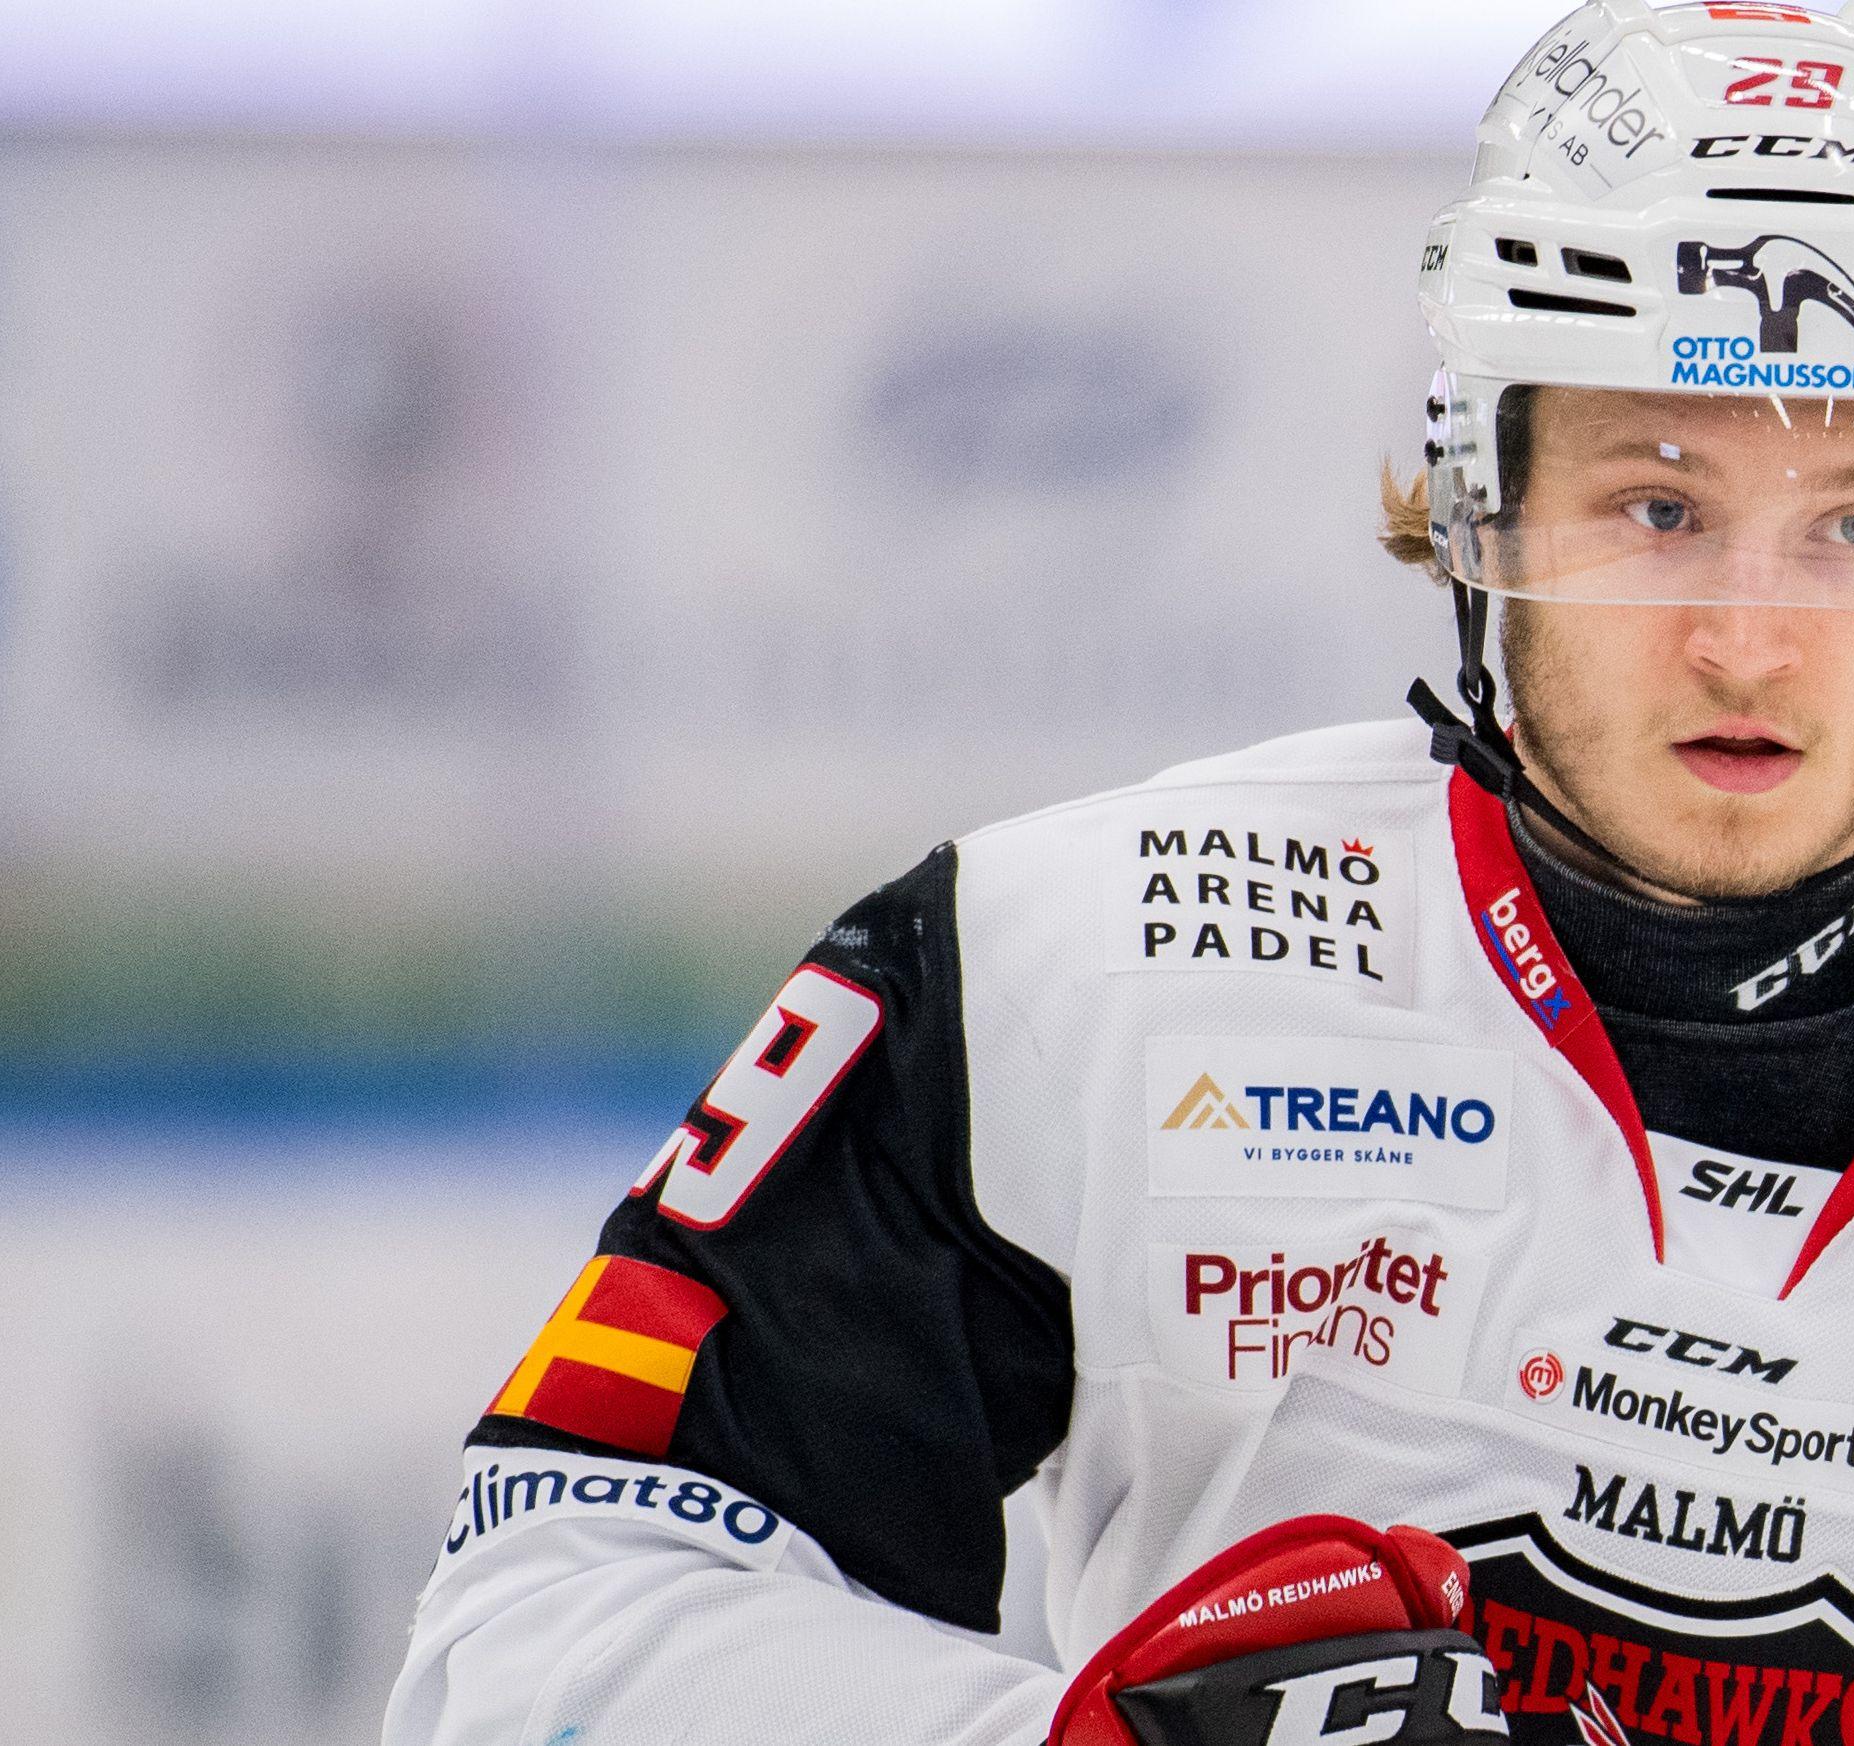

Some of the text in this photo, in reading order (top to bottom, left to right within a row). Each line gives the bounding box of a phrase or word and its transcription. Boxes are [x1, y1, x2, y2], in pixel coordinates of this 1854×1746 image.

[1723, 56, 1844, 110] 29
[1558, 135, 1589, 166] AB
[1420, 245, 1449, 273] CCM
[1672, 336, 1755, 361] OTTO
[1141, 872, 1383, 932] ARENA
[1143, 922, 1383, 982] PADEL
[627, 962, 884, 1232] 9
[1245, 1085, 1495, 1145] TREANO
[1244, 1147, 1414, 1165] VI BYGGER SKÅNE
[1679, 1159, 1804, 1217] SHL
[1185, 1236, 1449, 1317] Prioritet
[1603, 1316, 1799, 1384] CCM
[447, 1463, 780, 1555] climat80
[1564, 1464, 1808, 1564] MALMÖ
[1178, 1561, 1383, 1629] MALMÖ REDHAWKS
